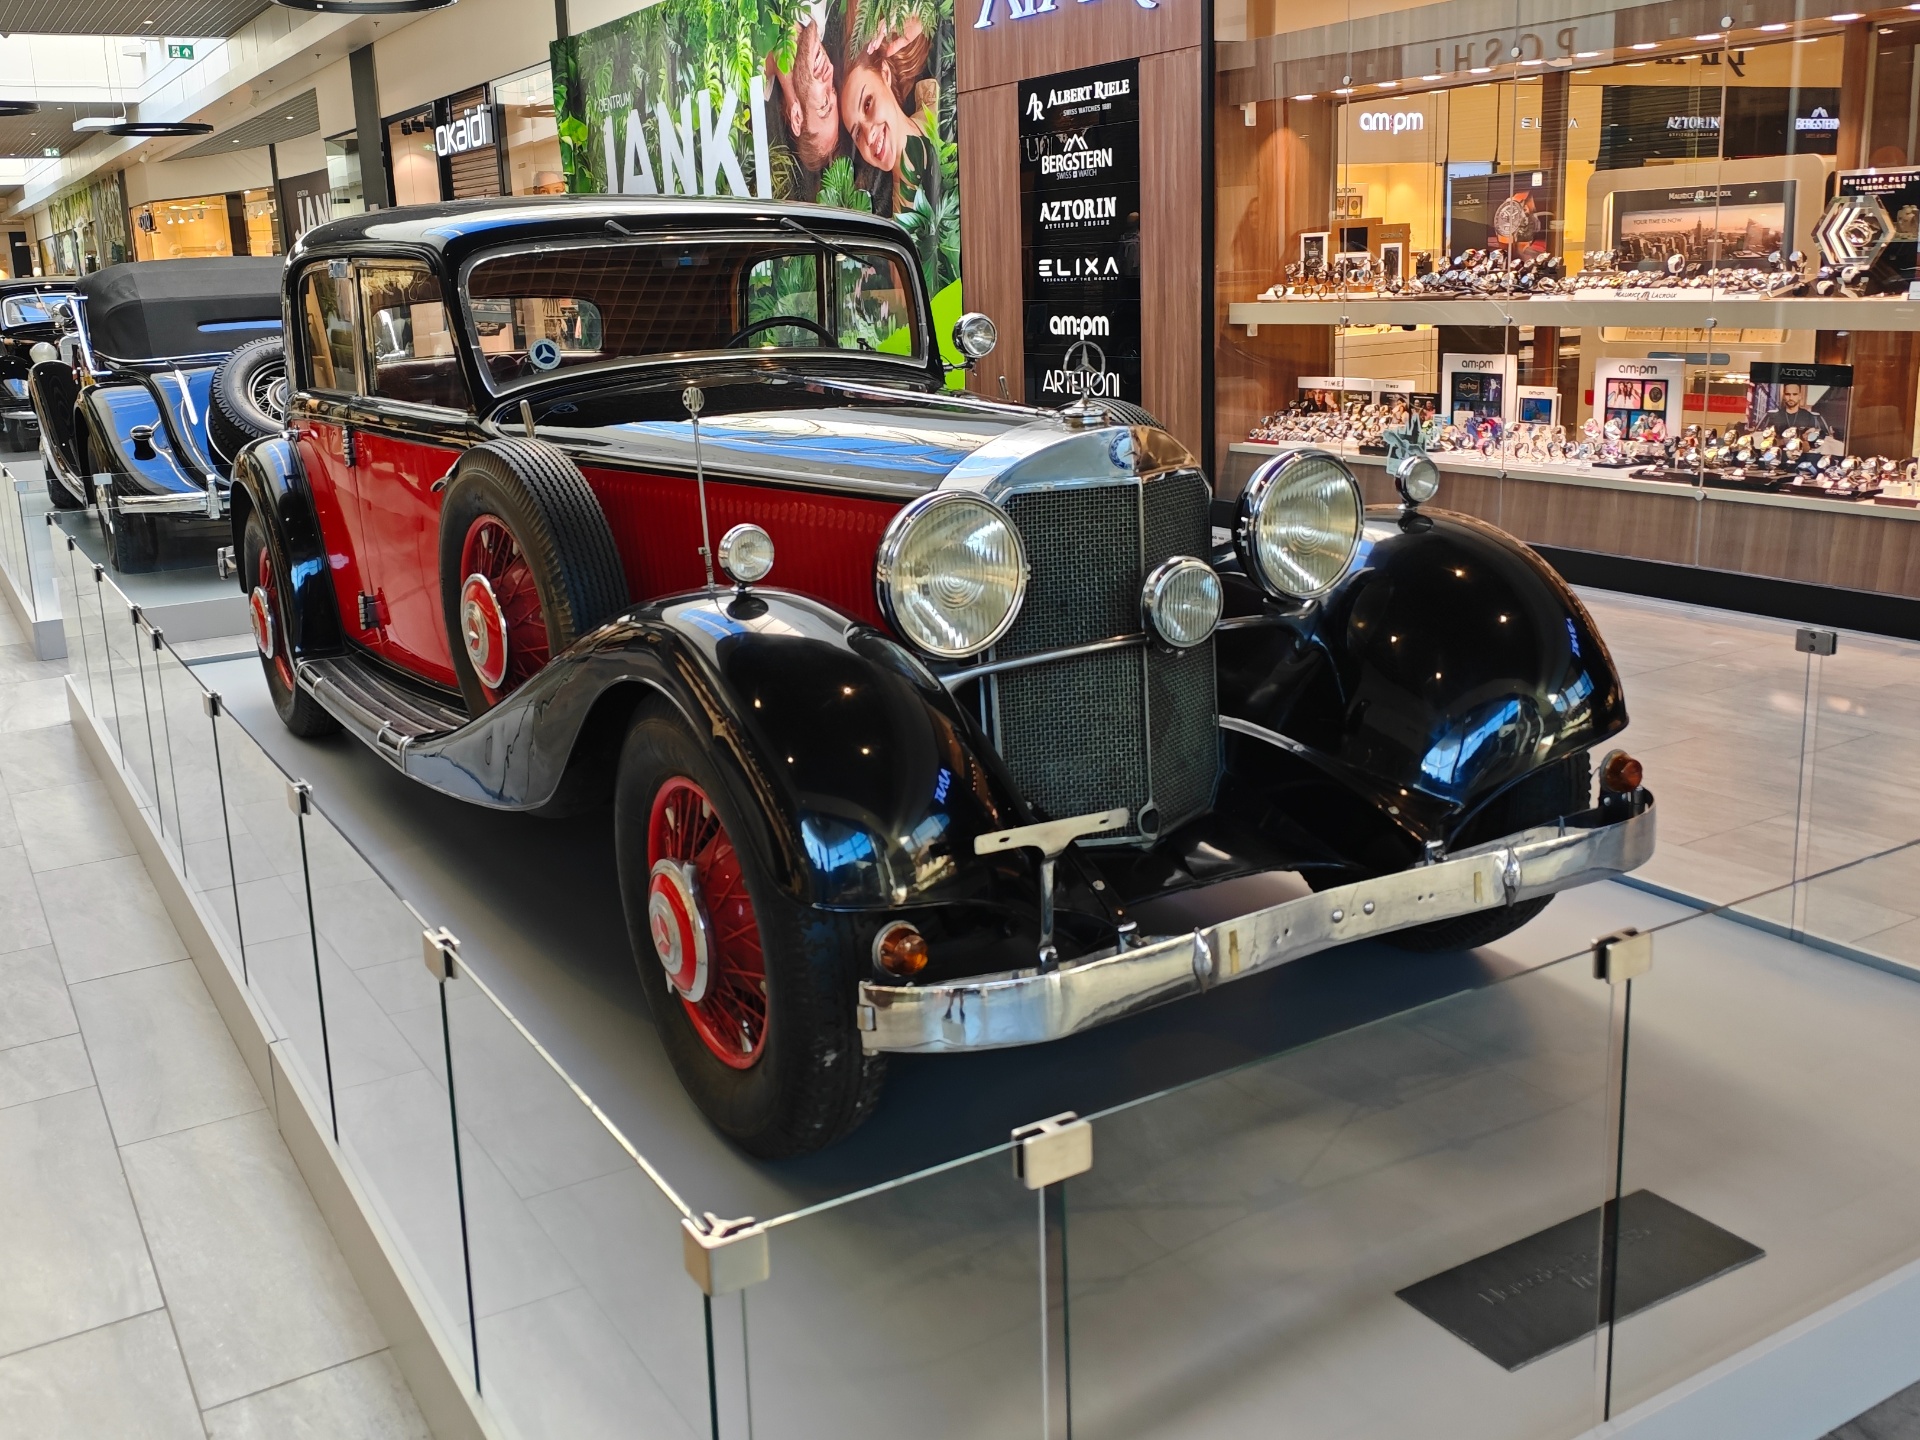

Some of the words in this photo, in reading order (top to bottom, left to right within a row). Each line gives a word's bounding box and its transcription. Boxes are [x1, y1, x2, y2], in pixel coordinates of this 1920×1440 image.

[600, 92, 632, 112] CENTRUM
[1047, 85, 1093, 109] ALBERT
[1093, 79, 1131, 99] RIELE
[1062, 107, 1078, 117] SWISS
[435, 103, 487, 157] okaïdi
[1359, 112, 1424, 135] am:pm
[1666, 116, 1722, 130] AZTORIN
[1041, 147, 1113, 175] BERGSTERN
[1056, 171, 1072, 181] SWISS
[1078, 168, 1098, 179] WATCH
[1039, 196, 1117, 222] AZTORIN
[1044, 221, 1079, 230] ATTITUDE
[1083, 219, 1110, 227] INSIDE
[1038, 256, 1119, 277] ELIXA
[1049, 315, 1110, 340] am:pm
[1461, 359, 1494, 371] am:pm
[1618, 364, 1658, 376] am:pm
